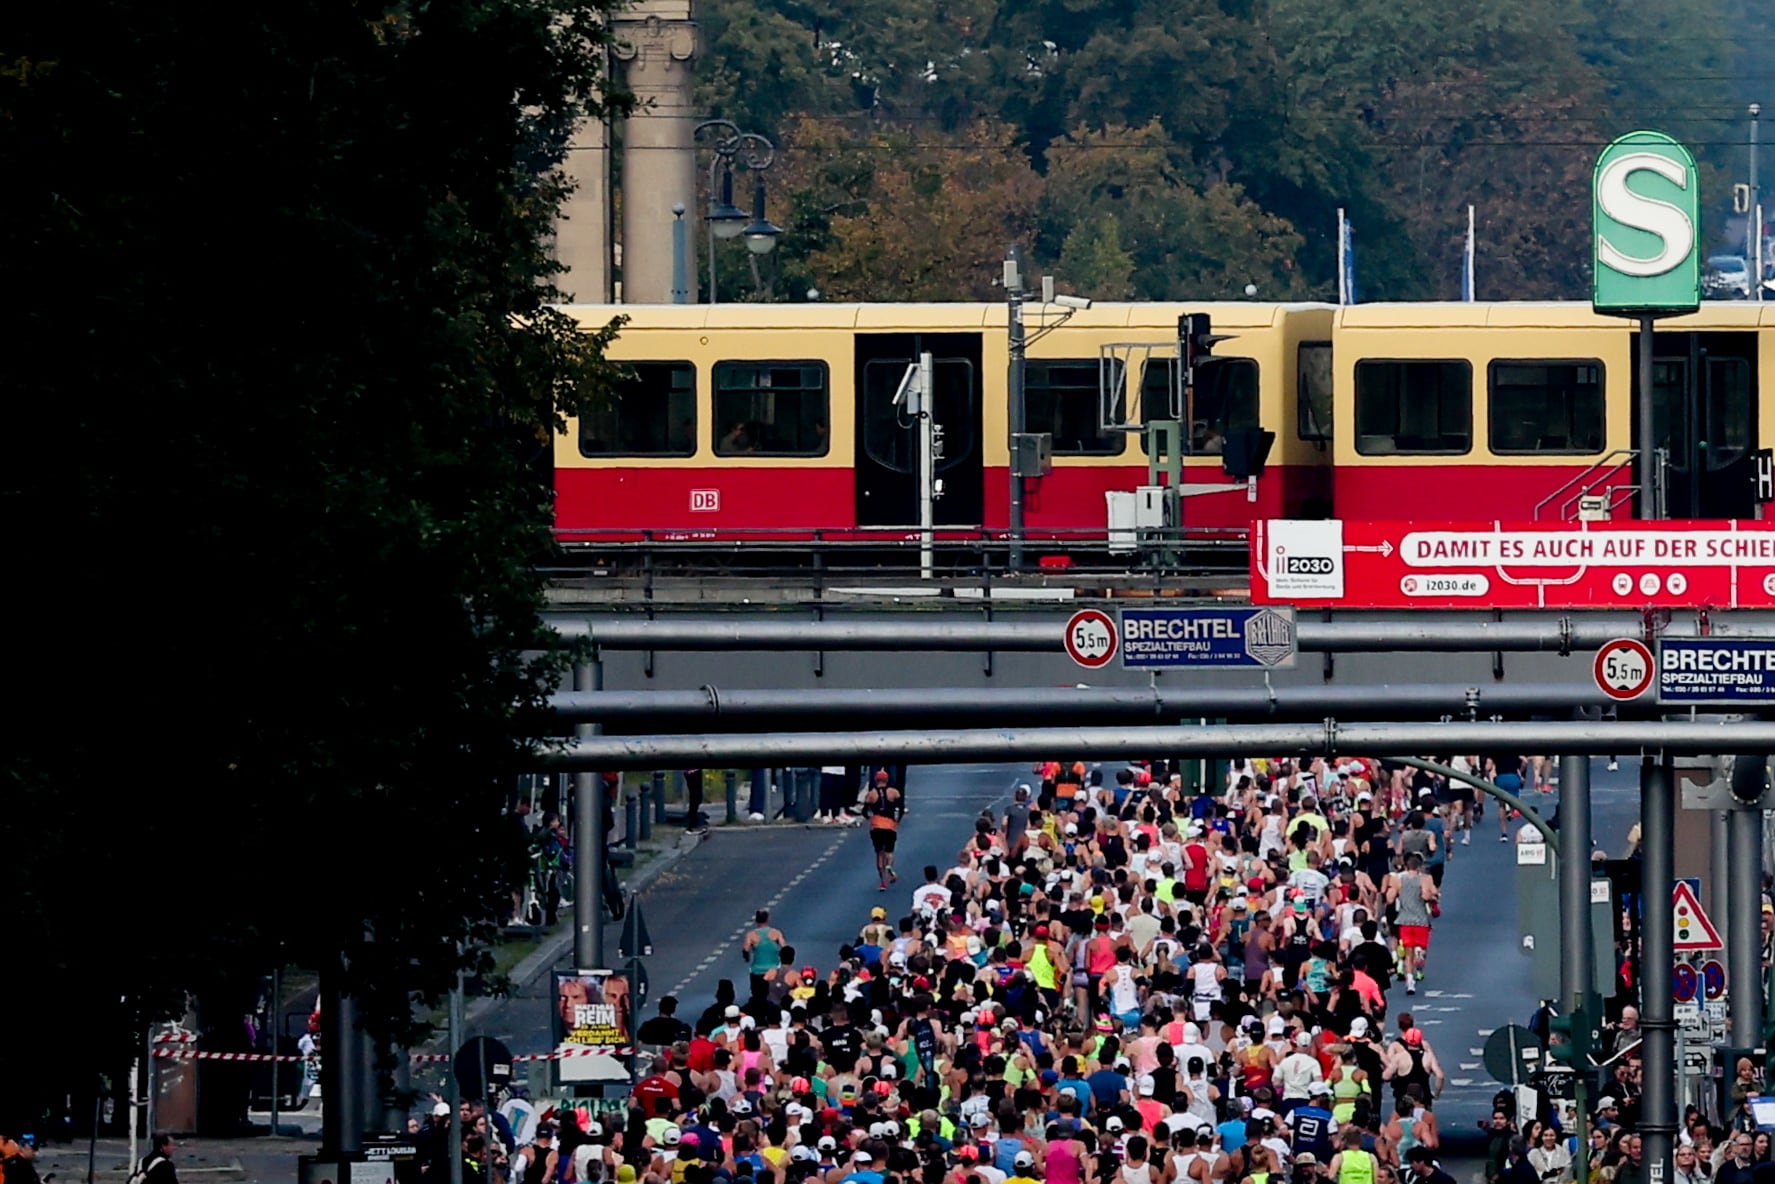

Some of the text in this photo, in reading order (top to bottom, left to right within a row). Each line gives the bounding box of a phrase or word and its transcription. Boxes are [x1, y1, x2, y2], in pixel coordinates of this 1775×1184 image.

[1597, 151, 1694, 277] S
[1759, 457, 1772, 498] H
[694, 493, 716, 508] DB
[1417, 540, 1491, 558] DAMIT
[1500, 540, 1524, 558] ES
[1533, 540, 1593, 558] AUCH
[1603, 539, 1645, 558] AUF
[1654, 539, 1698, 558] DER
[1426, 578, 1478, 593] i2030.de
[1124, 618, 1241, 639] BRECHTEL
[1124, 641, 1210, 653] SPEZIALTIEFBAU
[1661, 672, 1763, 685] SPEZIALTIEFBAU
[573, 1010, 617, 1028] REIM
